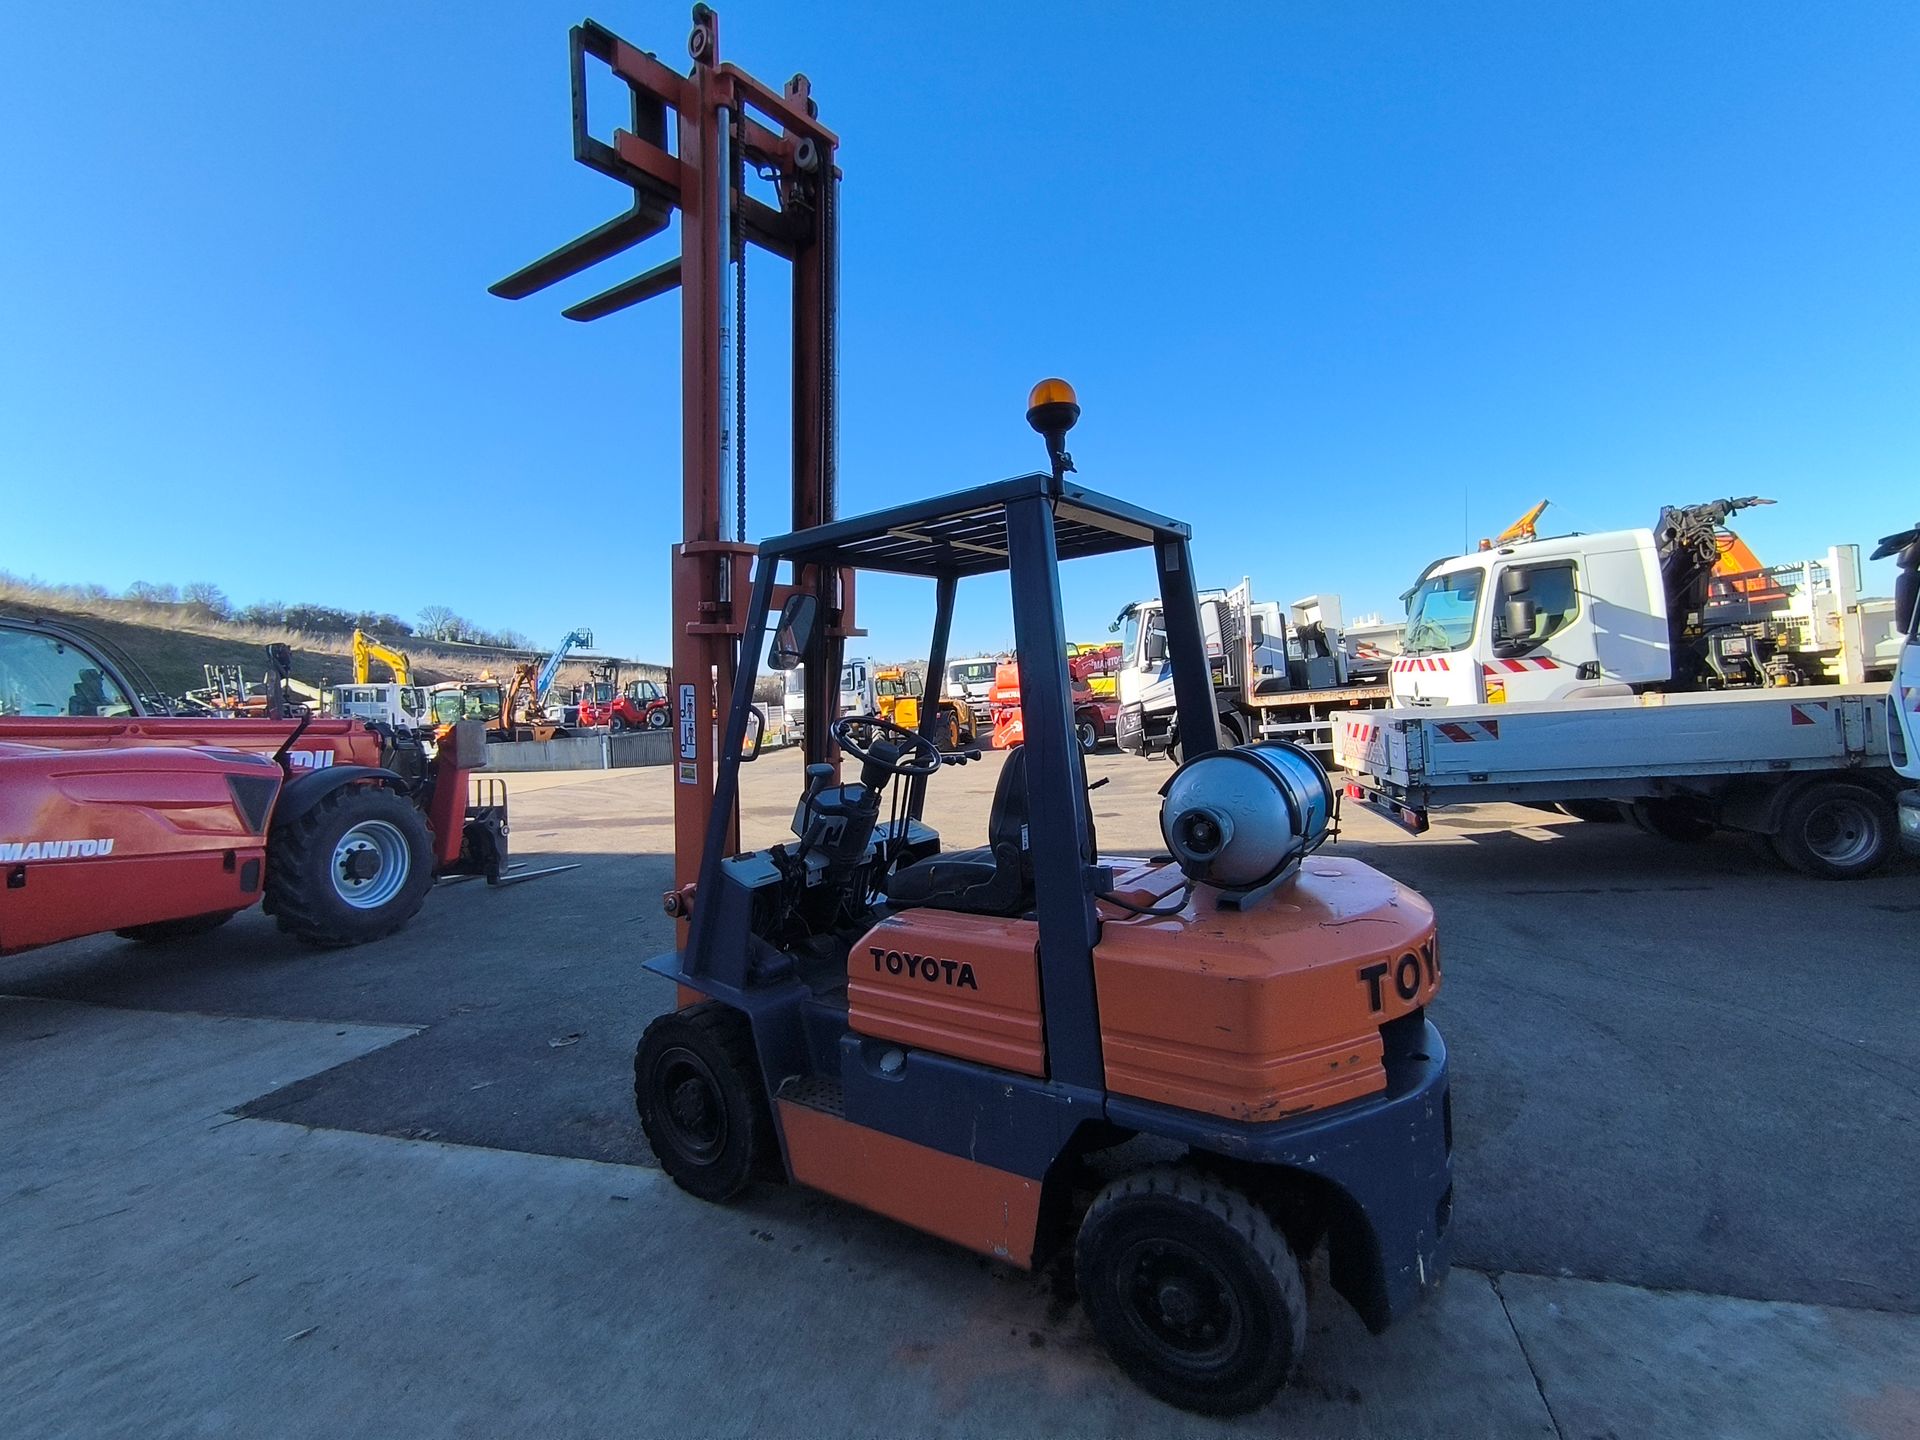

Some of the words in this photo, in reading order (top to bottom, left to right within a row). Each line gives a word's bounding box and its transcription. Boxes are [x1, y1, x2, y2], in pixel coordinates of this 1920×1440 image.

[0, 838, 114, 861] MANITOU
[869, 946, 978, 990] TOYOTA
[1360, 931, 1440, 1012] TOY
